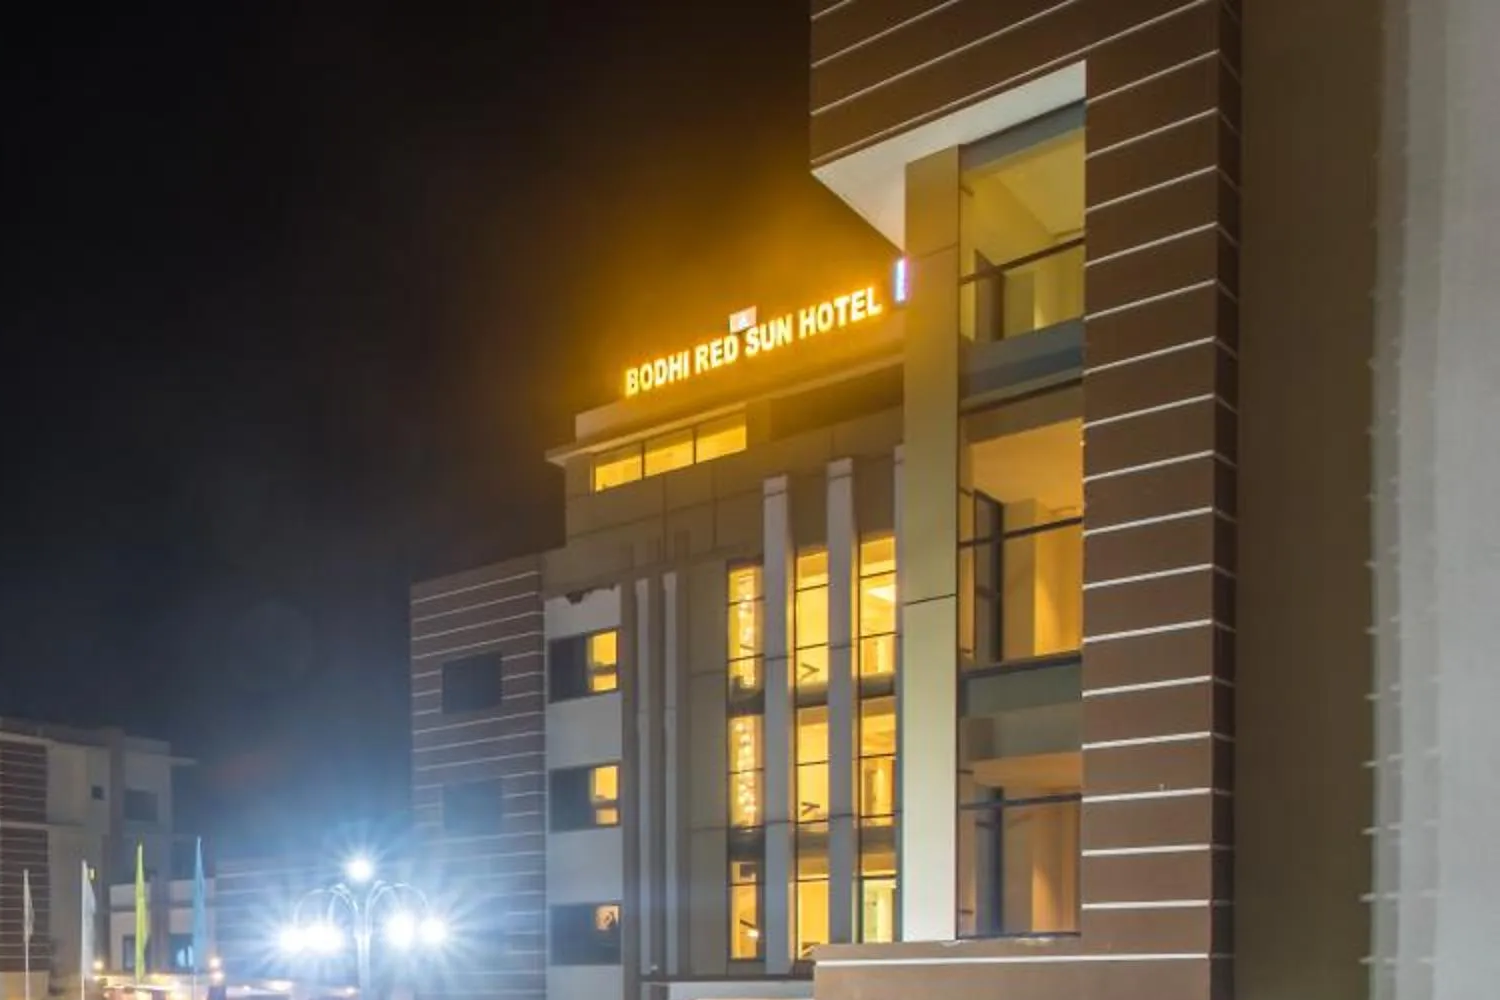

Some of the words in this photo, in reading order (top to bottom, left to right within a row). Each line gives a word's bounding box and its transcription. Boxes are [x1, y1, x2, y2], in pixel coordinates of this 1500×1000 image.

[625, 350, 690, 398] BODHI
[695, 335, 738, 374] RED
[745, 313, 793, 357] SUN
[799, 287, 882, 340] HOTEL
